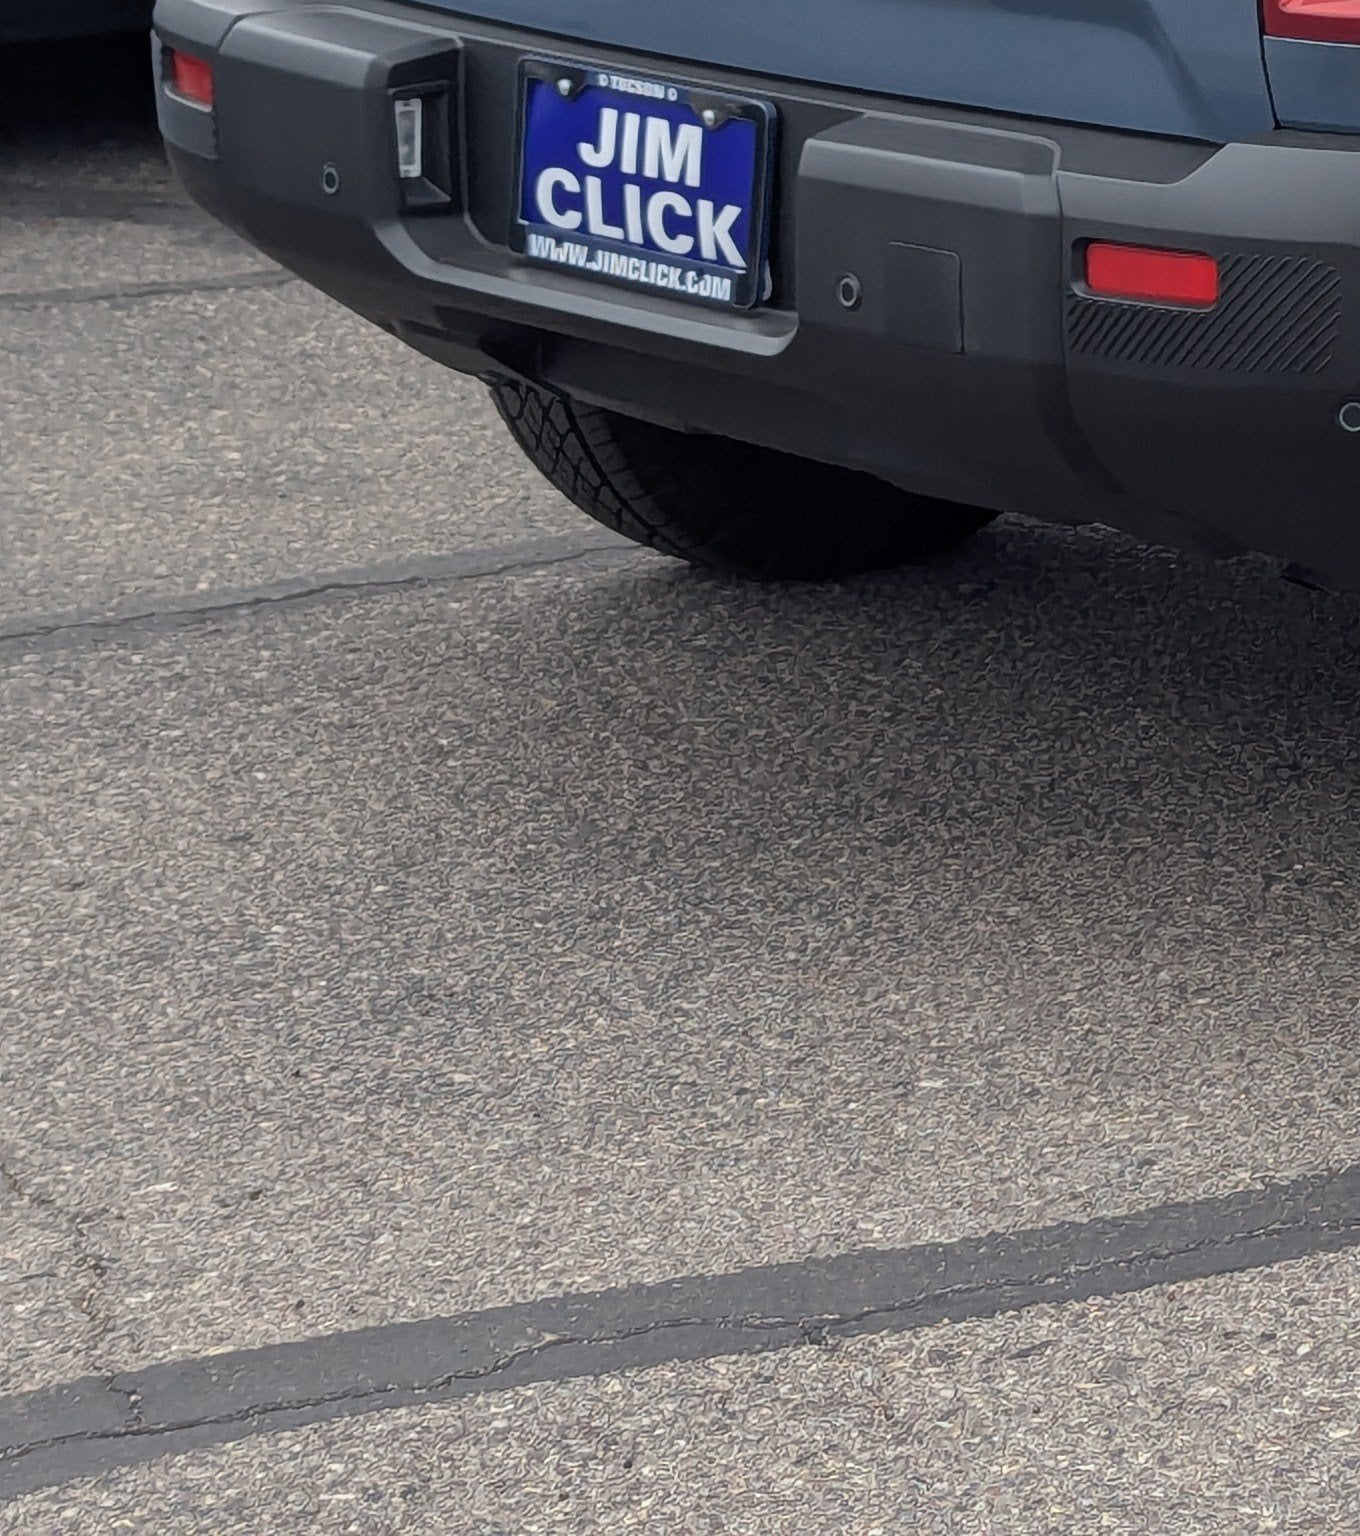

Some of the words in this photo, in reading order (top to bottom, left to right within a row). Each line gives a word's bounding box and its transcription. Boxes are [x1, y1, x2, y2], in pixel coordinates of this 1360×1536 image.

[577, 107, 703, 187] JIM
[537, 167, 747, 268] CLICK
[527, 233, 732, 301] WWW.JIMCLICK.COM
